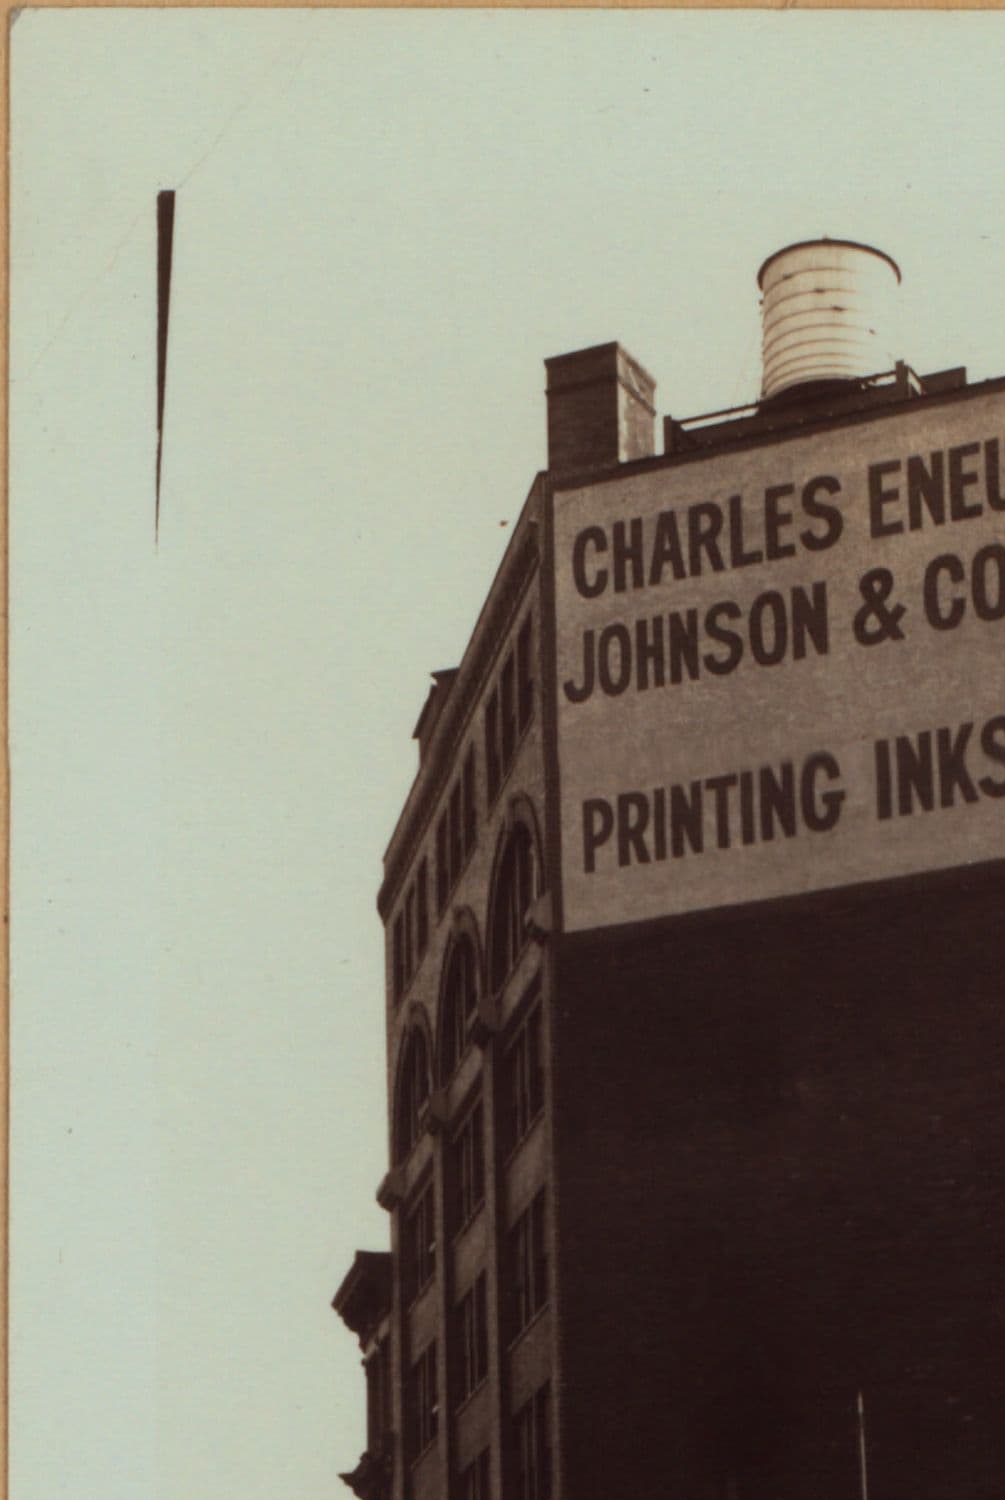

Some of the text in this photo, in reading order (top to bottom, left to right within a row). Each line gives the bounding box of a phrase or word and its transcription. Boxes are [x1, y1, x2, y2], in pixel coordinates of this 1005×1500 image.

[572, 475, 845, 600] CHARLES
[563, 581, 830, 704] JOHNSON
[852, 567, 908, 647] &
[582, 750, 847, 874] PRINTING
